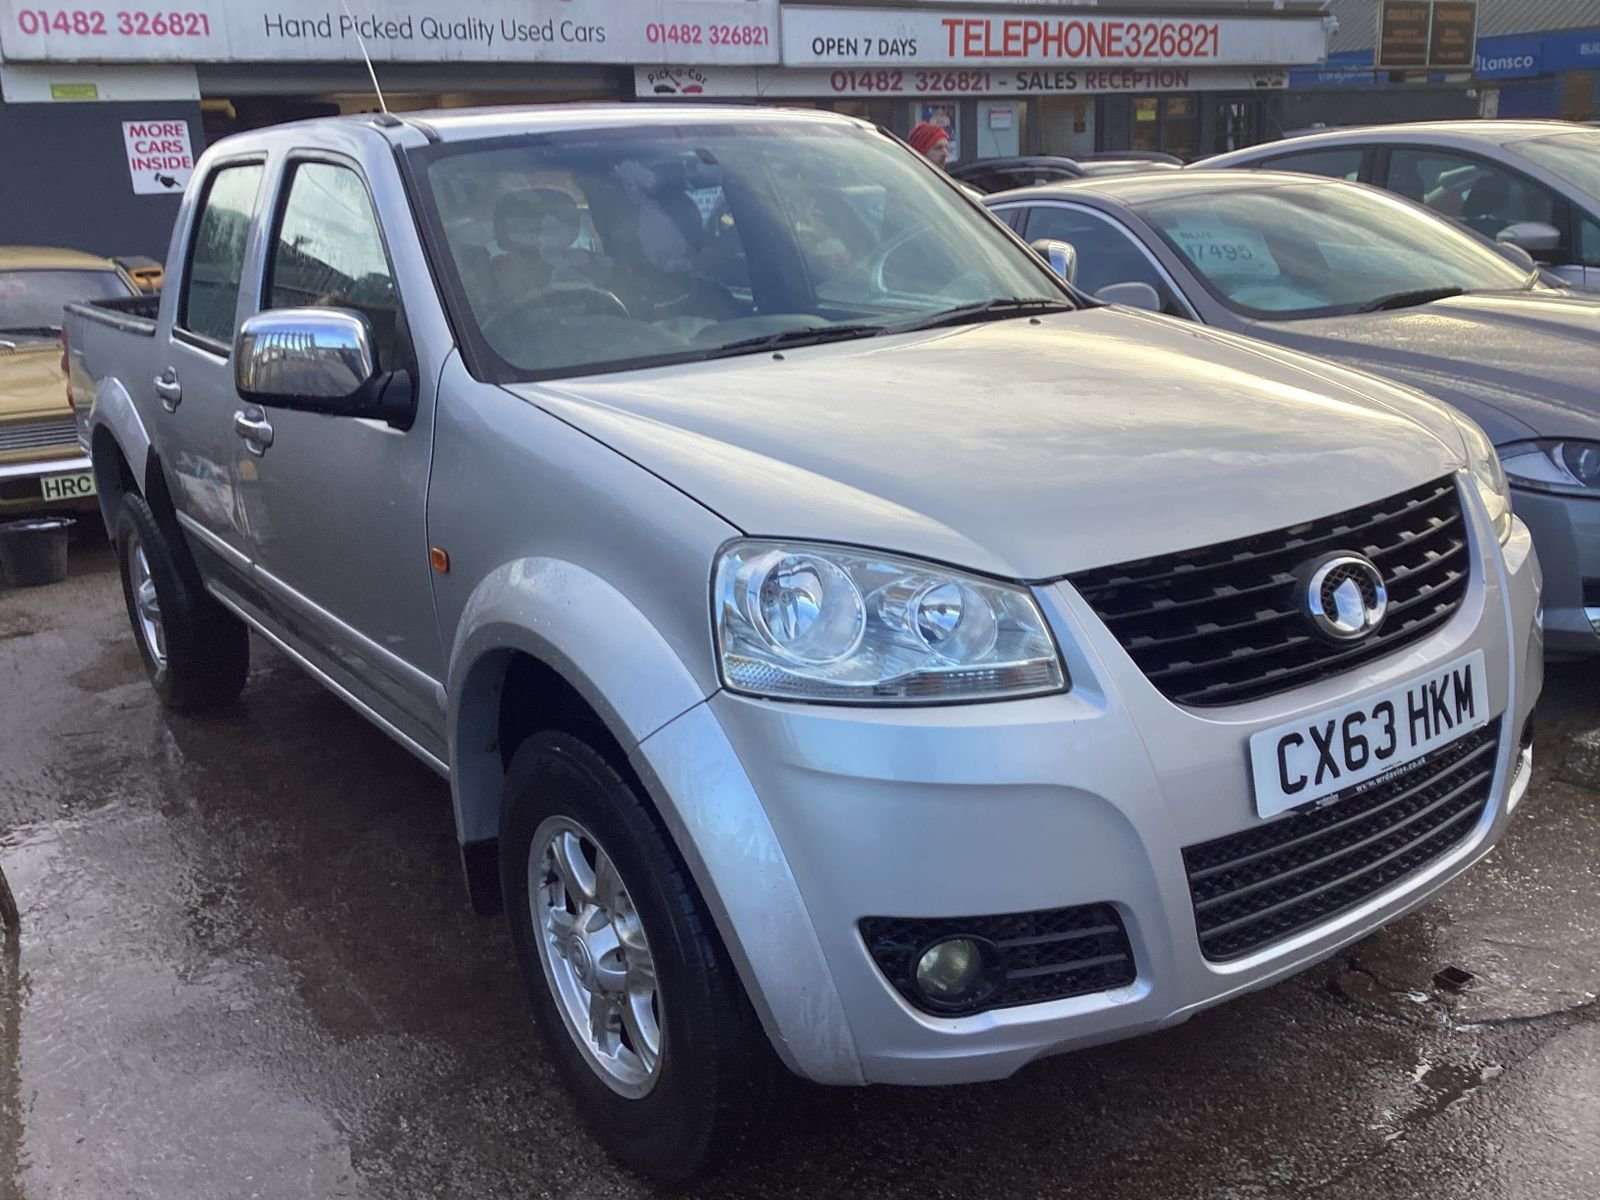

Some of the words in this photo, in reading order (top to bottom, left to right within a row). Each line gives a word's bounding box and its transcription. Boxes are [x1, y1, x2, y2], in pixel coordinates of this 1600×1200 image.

[20, 10, 107, 35] 01482
[117, 11, 210, 36] 326821
[264, 14, 331, 37] Hand
[340, 15, 413, 40] Picked
[420, 17, 495, 46] Quality
[501, 19, 553, 42] Used
[560, 20, 606, 43] Cars
[646, 23, 702, 45] 01482
[709, 25, 769, 46] 326821
[942, 19, 1219, 58] TELEPHONE326821
[812, 37, 858, 57] OPEN
[864, 39, 873, 57] 7
[878, 39, 917, 57] DAYS
[1481, 55, 1534, 71] Lansco
[830, 71, 903, 92] 01482
[914, 72, 990, 91] 326821
[1015, 71, 1077, 90] SALES
[1085, 70, 1188, 89] RECEPTION
[130, 124, 184, 137] MORE
[135, 141, 183, 154] CARS
[132, 156, 192, 170] INSIDE
[44, 475, 92, 497] HRC
[1277, 701, 1397, 795] CX63
[1407, 664, 1475, 747] HKM
